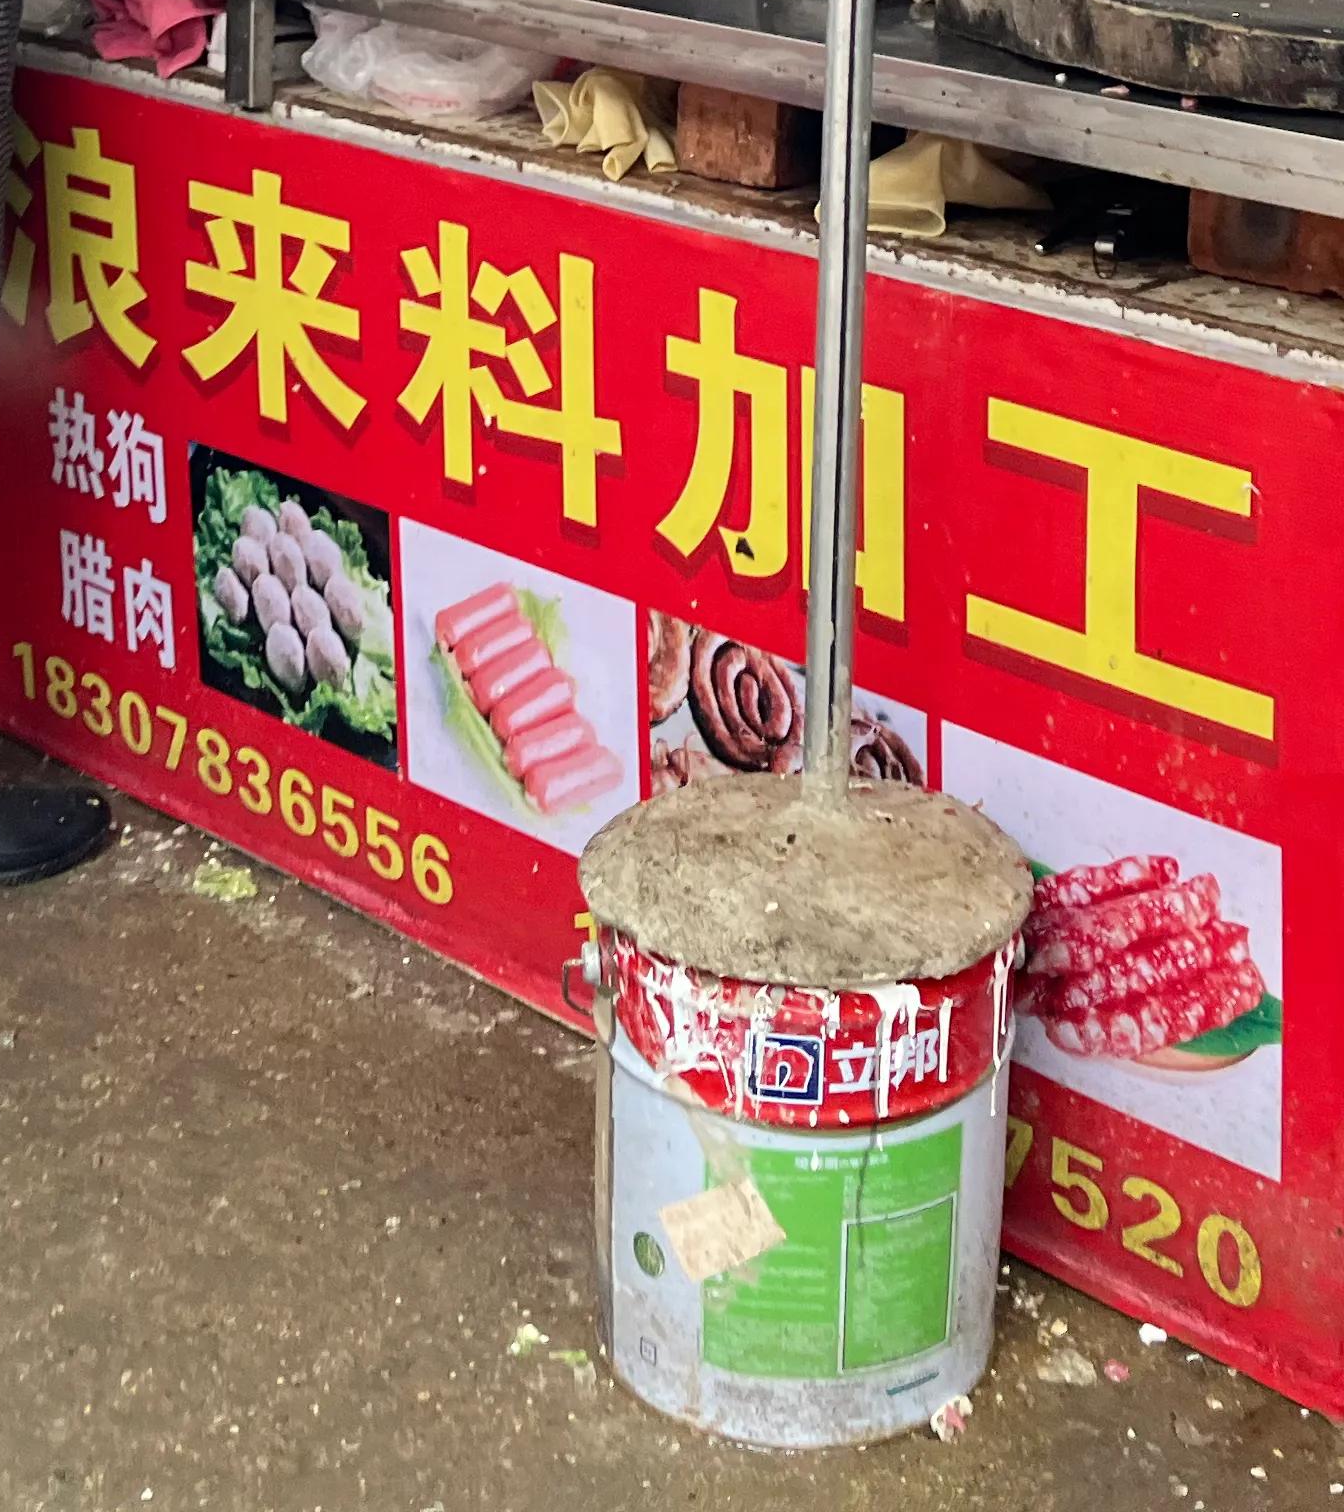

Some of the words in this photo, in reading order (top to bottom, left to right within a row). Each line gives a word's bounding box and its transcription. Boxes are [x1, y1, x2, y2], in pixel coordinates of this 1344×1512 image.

[48, 386, 168, 525] 热狗
[59, 527, 176, 670] 腊肉
[12, 640, 455, 906] 18307836556
[829, 1028, 941, 1094] 立邦
